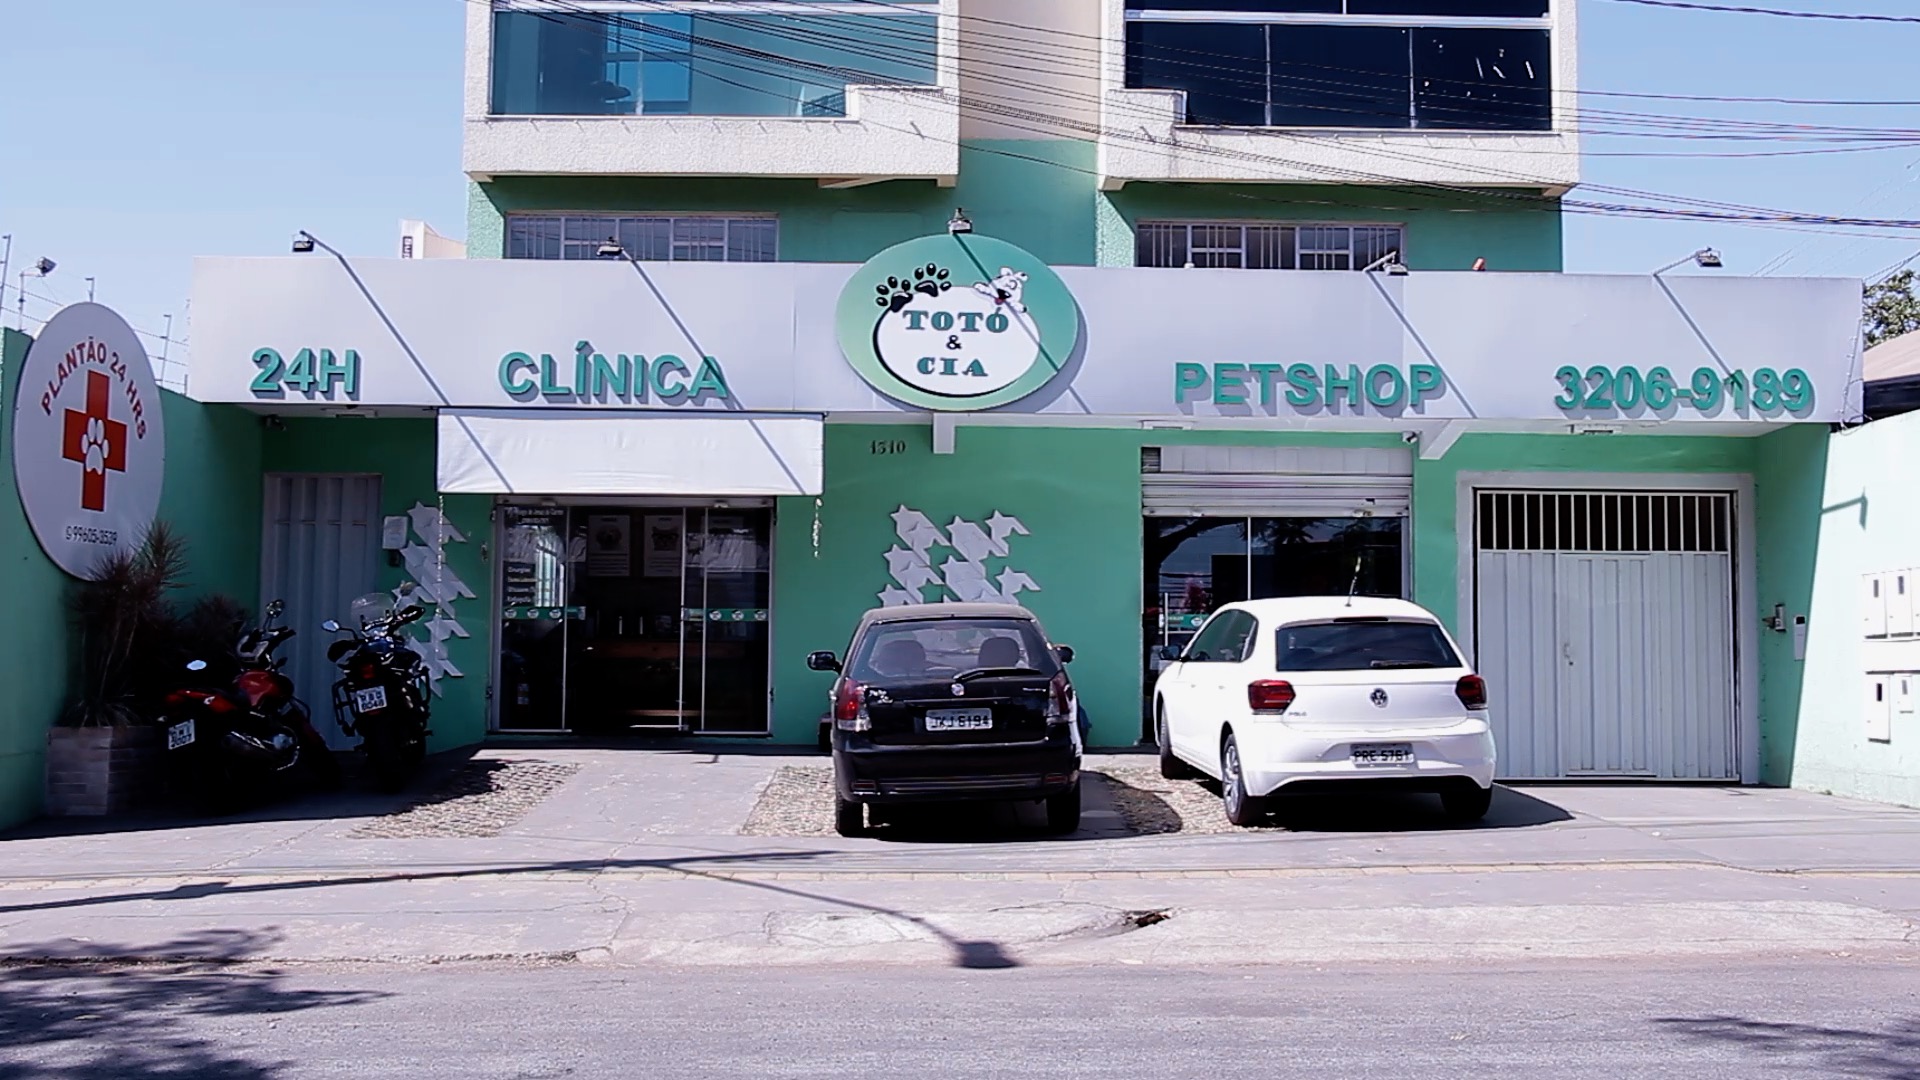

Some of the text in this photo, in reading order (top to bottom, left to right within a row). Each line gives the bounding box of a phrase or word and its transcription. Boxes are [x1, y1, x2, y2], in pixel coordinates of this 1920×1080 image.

[902, 306, 1009, 333] TOTÓ
[946, 335, 962, 350] &
[41, 336, 147, 440] PLANTÃO 24 HRS
[249, 347, 358, 395] 24H
[499, 340, 729, 400] CLÍNICA
[917, 357, 988, 377] CIA
[1174, 362, 1443, 408] PETSHOP
[1554, 365, 1813, 413] 3206-9189
